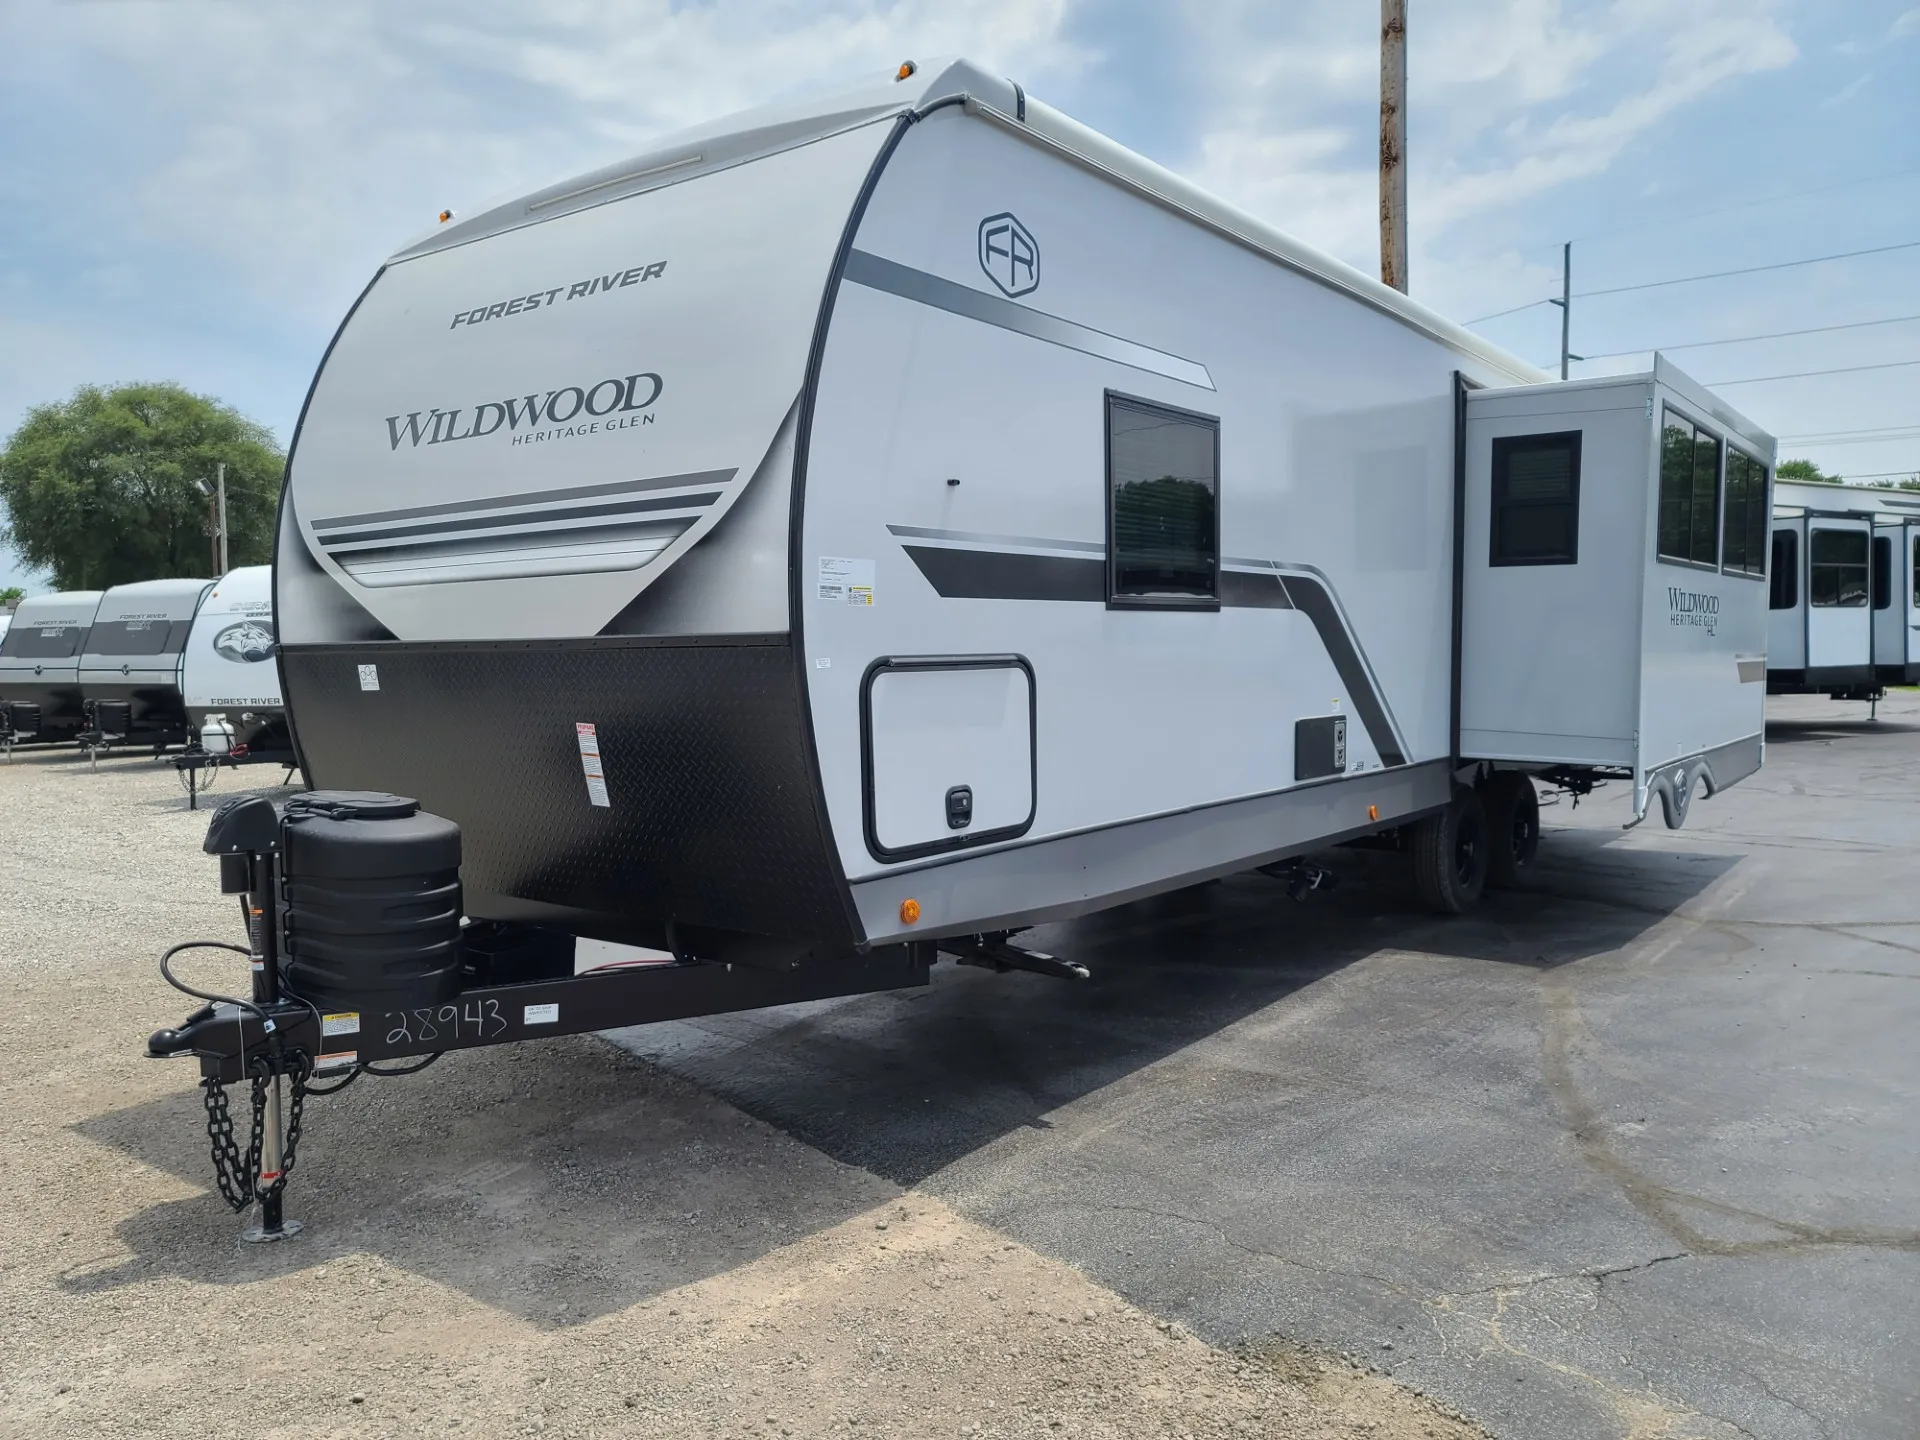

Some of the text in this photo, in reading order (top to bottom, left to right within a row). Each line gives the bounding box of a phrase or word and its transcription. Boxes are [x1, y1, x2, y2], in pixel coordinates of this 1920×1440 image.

[450, 260, 668, 330] FOREST RIVER
[385, 372, 663, 451] WILDWOOD
[511, 413, 656, 446] HERITAGE GLEN
[1668, 587, 1720, 614] WILDWOOD
[1670, 613, 1718, 628] HERITAGE GLEN
[250, 697, 280, 705] RIVER
[384, 999, 508, 1044] 28943
